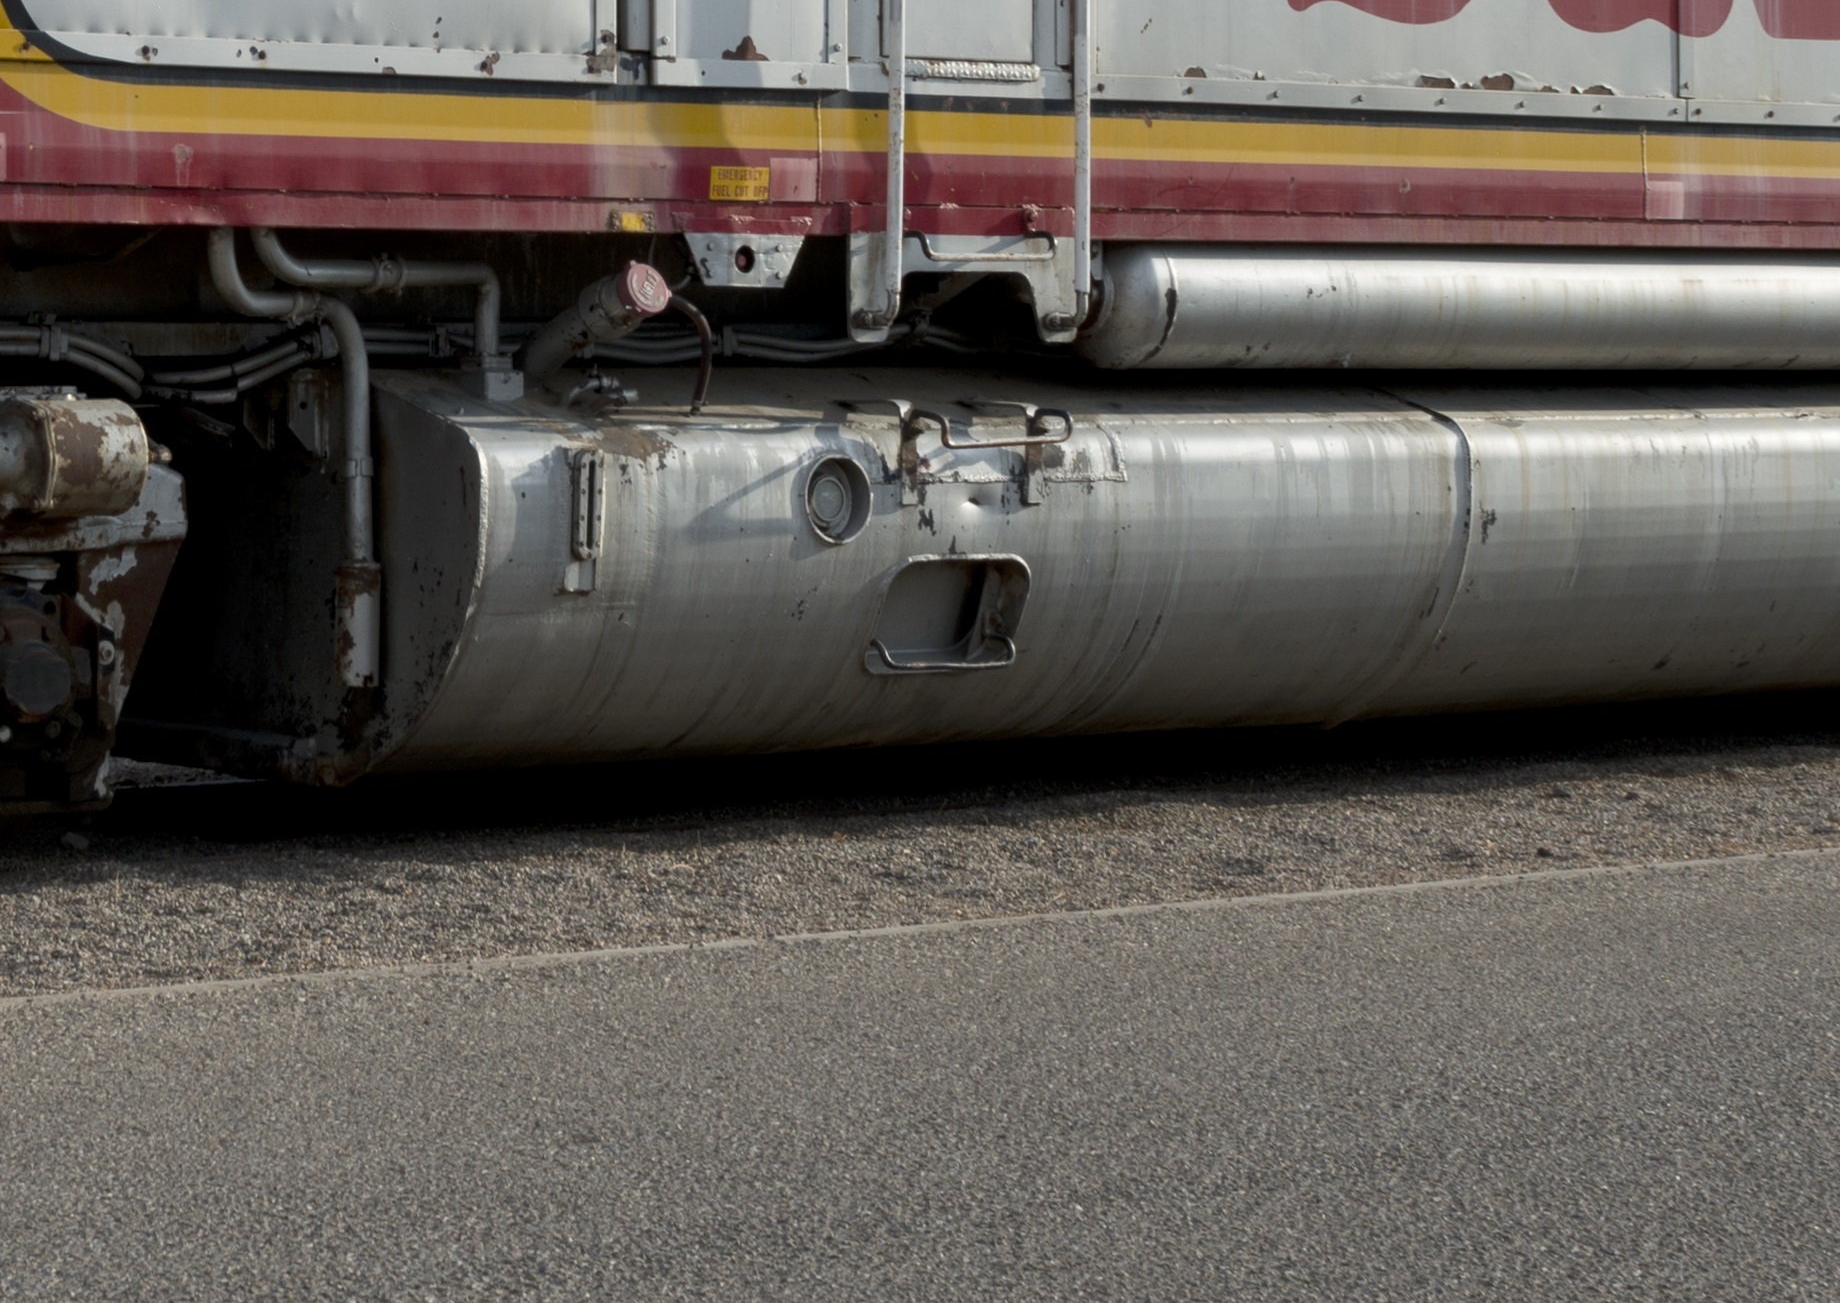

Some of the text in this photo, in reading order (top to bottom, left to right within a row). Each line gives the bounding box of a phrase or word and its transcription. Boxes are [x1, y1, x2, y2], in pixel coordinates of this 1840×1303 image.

[718, 169, 762, 181] EMERGENCY
[712, 185, 768, 197] FUEL CUT OFF
